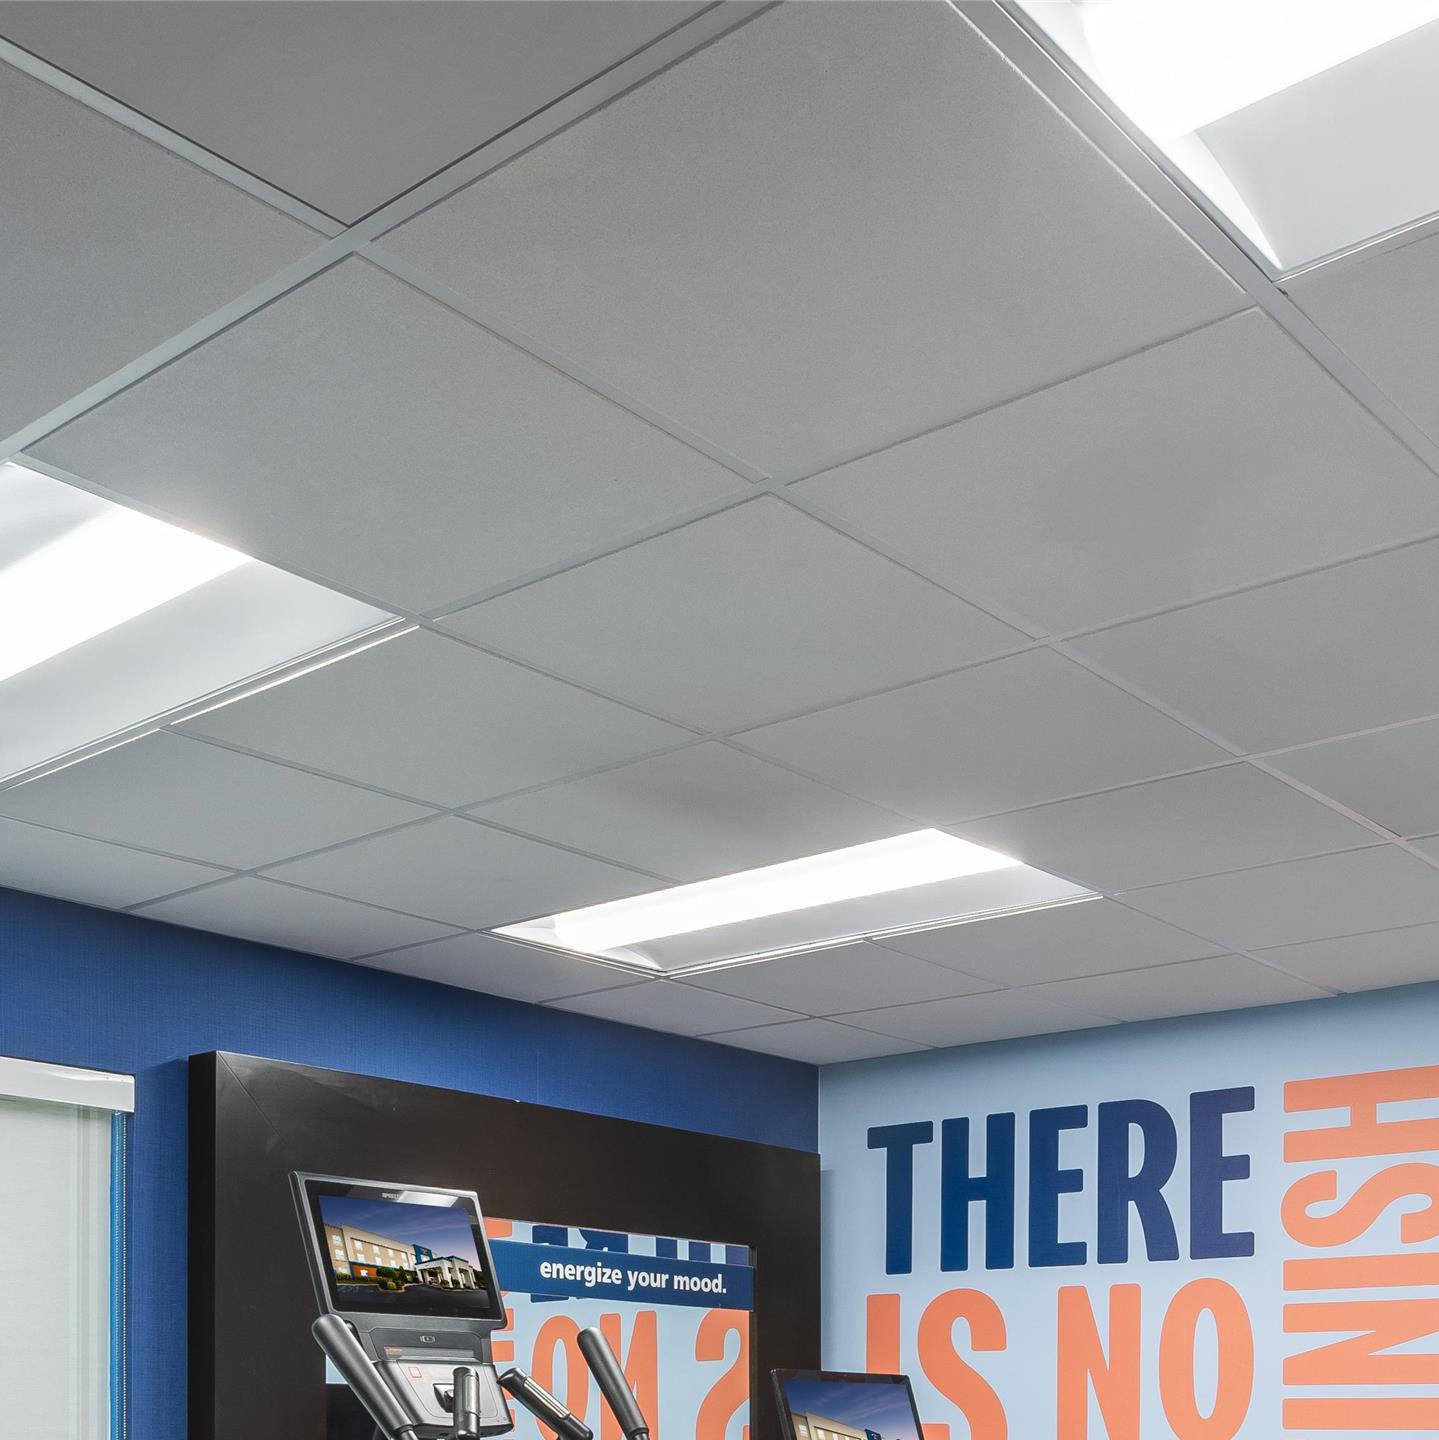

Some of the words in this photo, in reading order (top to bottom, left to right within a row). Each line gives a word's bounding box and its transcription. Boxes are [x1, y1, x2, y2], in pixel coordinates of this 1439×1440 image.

[866, 1085, 1256, 1275] THERE
[539, 1261, 622, 1288] energize
[627, 1270, 669, 1291] your
[673, 1273, 727, 1294] mood.
